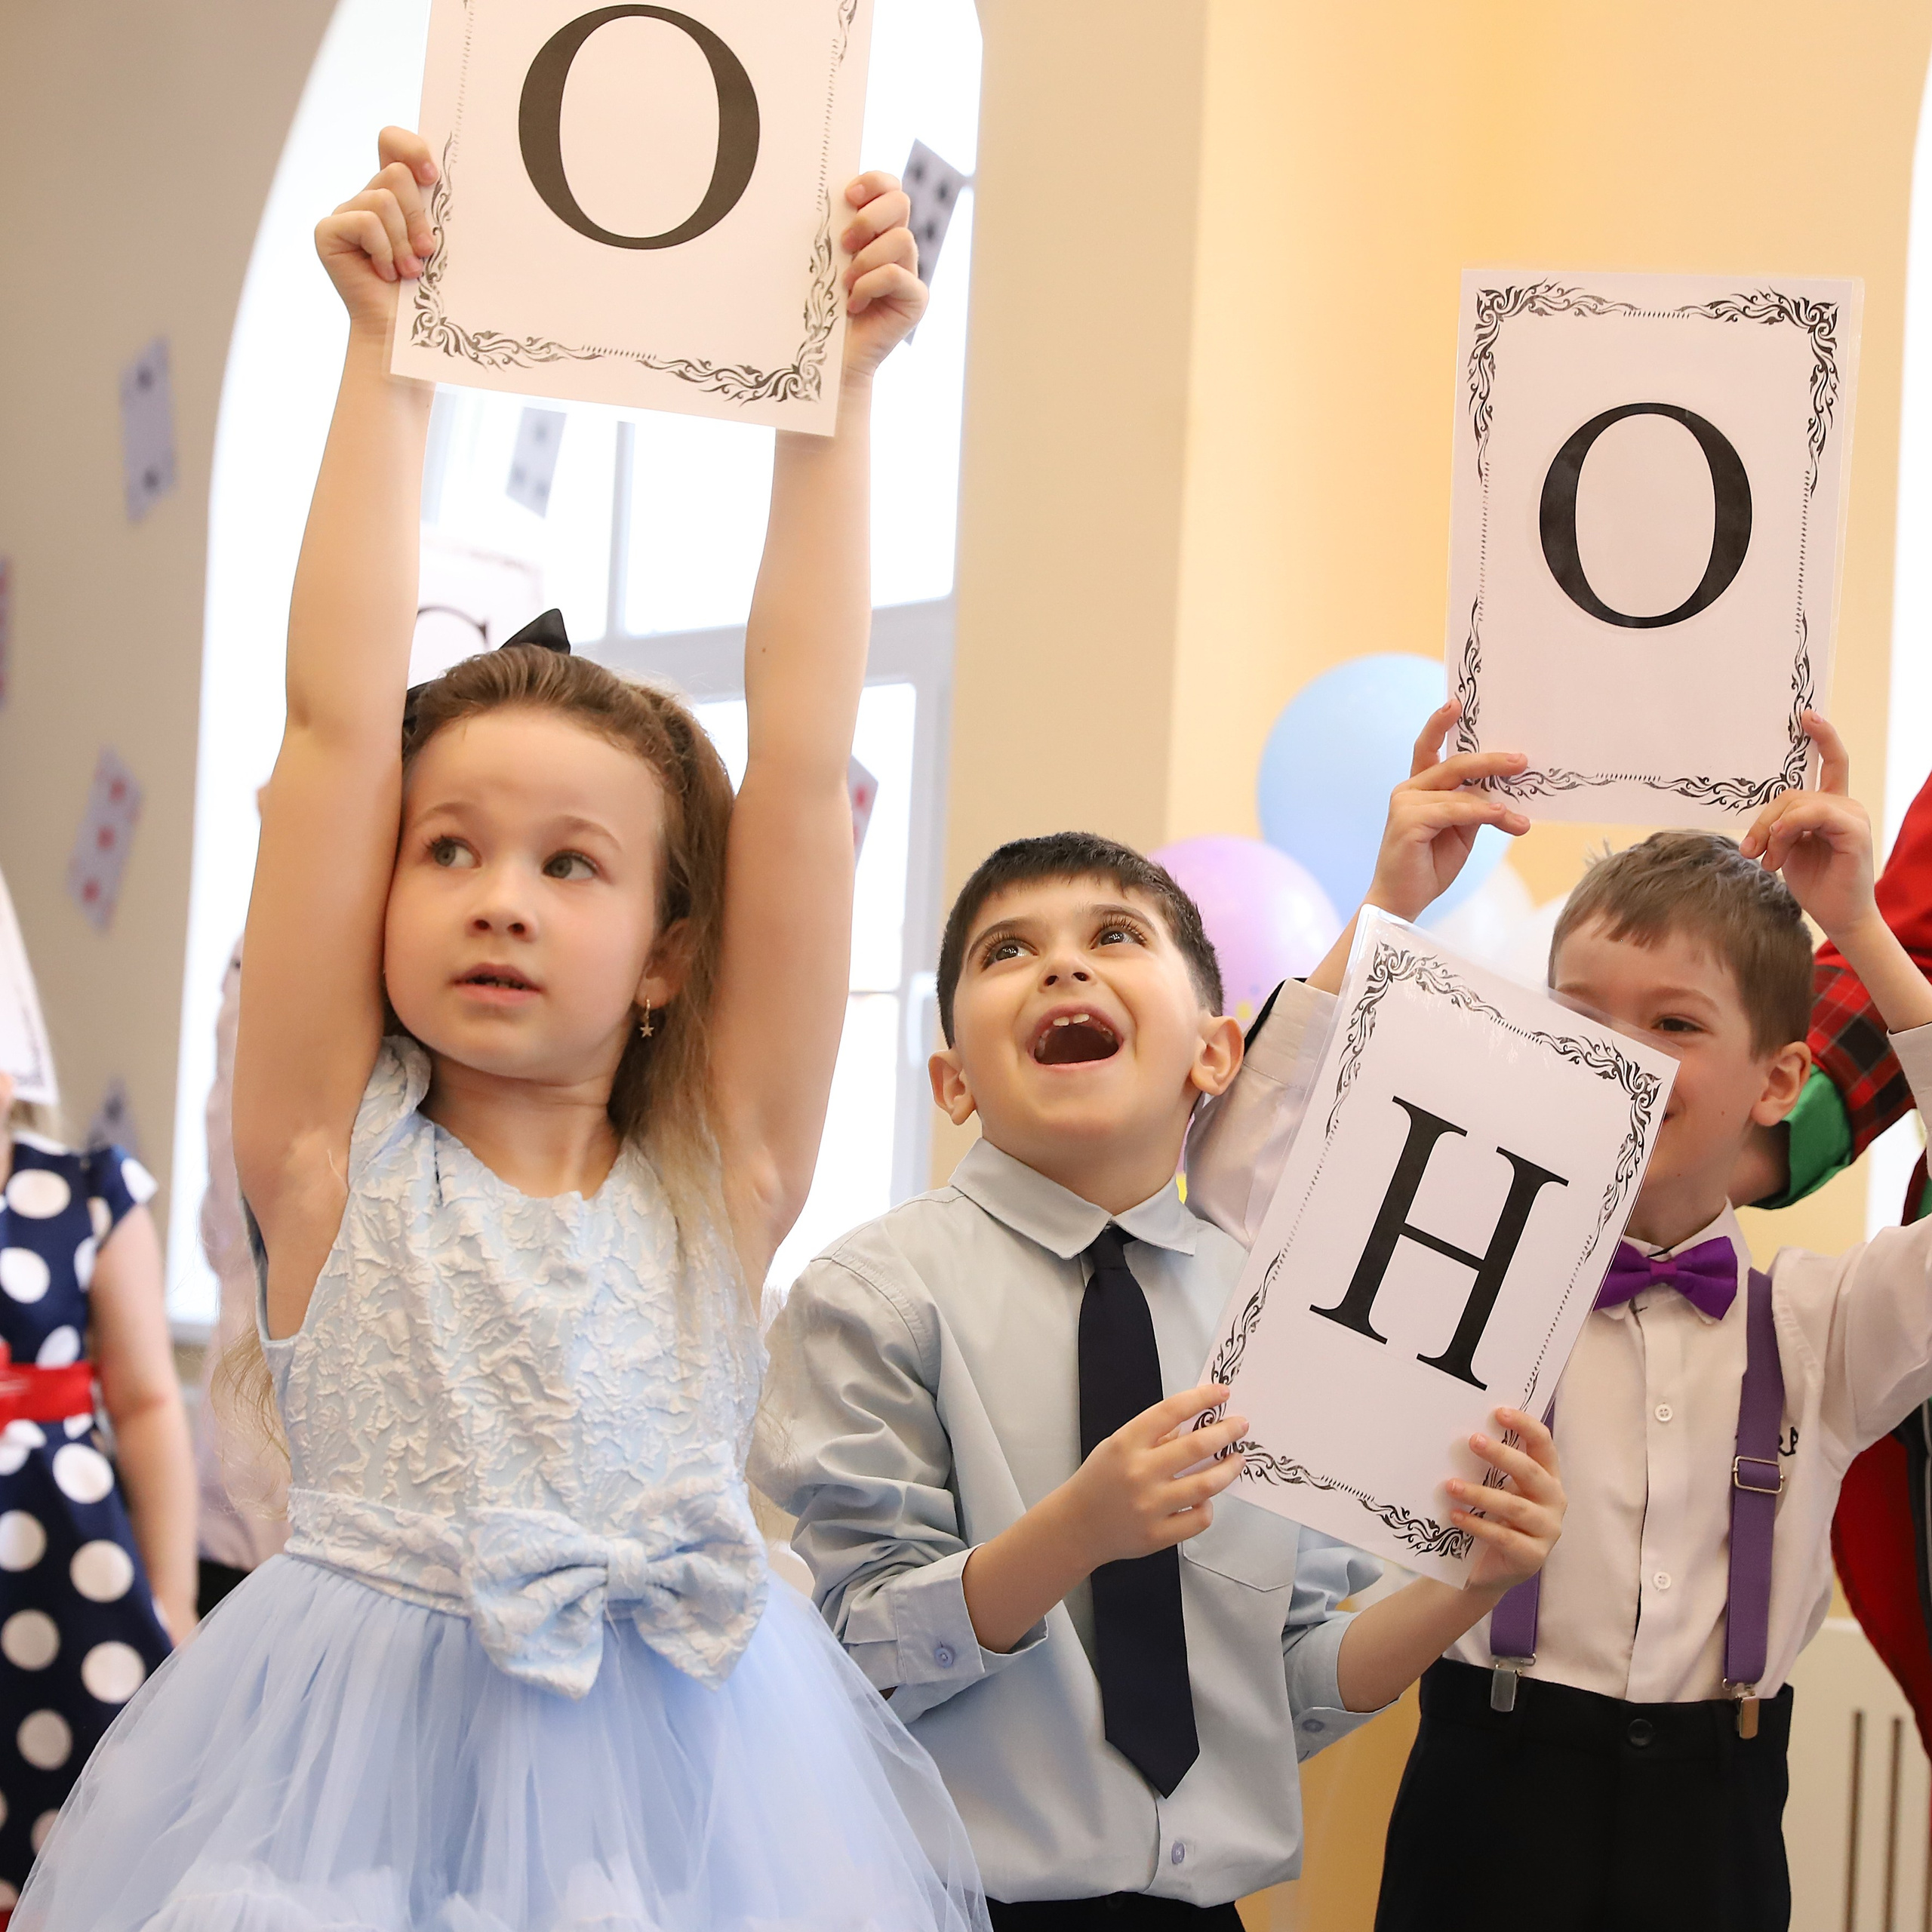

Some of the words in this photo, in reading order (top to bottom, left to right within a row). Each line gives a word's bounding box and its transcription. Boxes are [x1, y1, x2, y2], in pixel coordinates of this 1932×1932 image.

[518, 4, 761, 251] O
[1539, 402, 1753, 629] O
[1309, 1095, 1570, 1392] H
